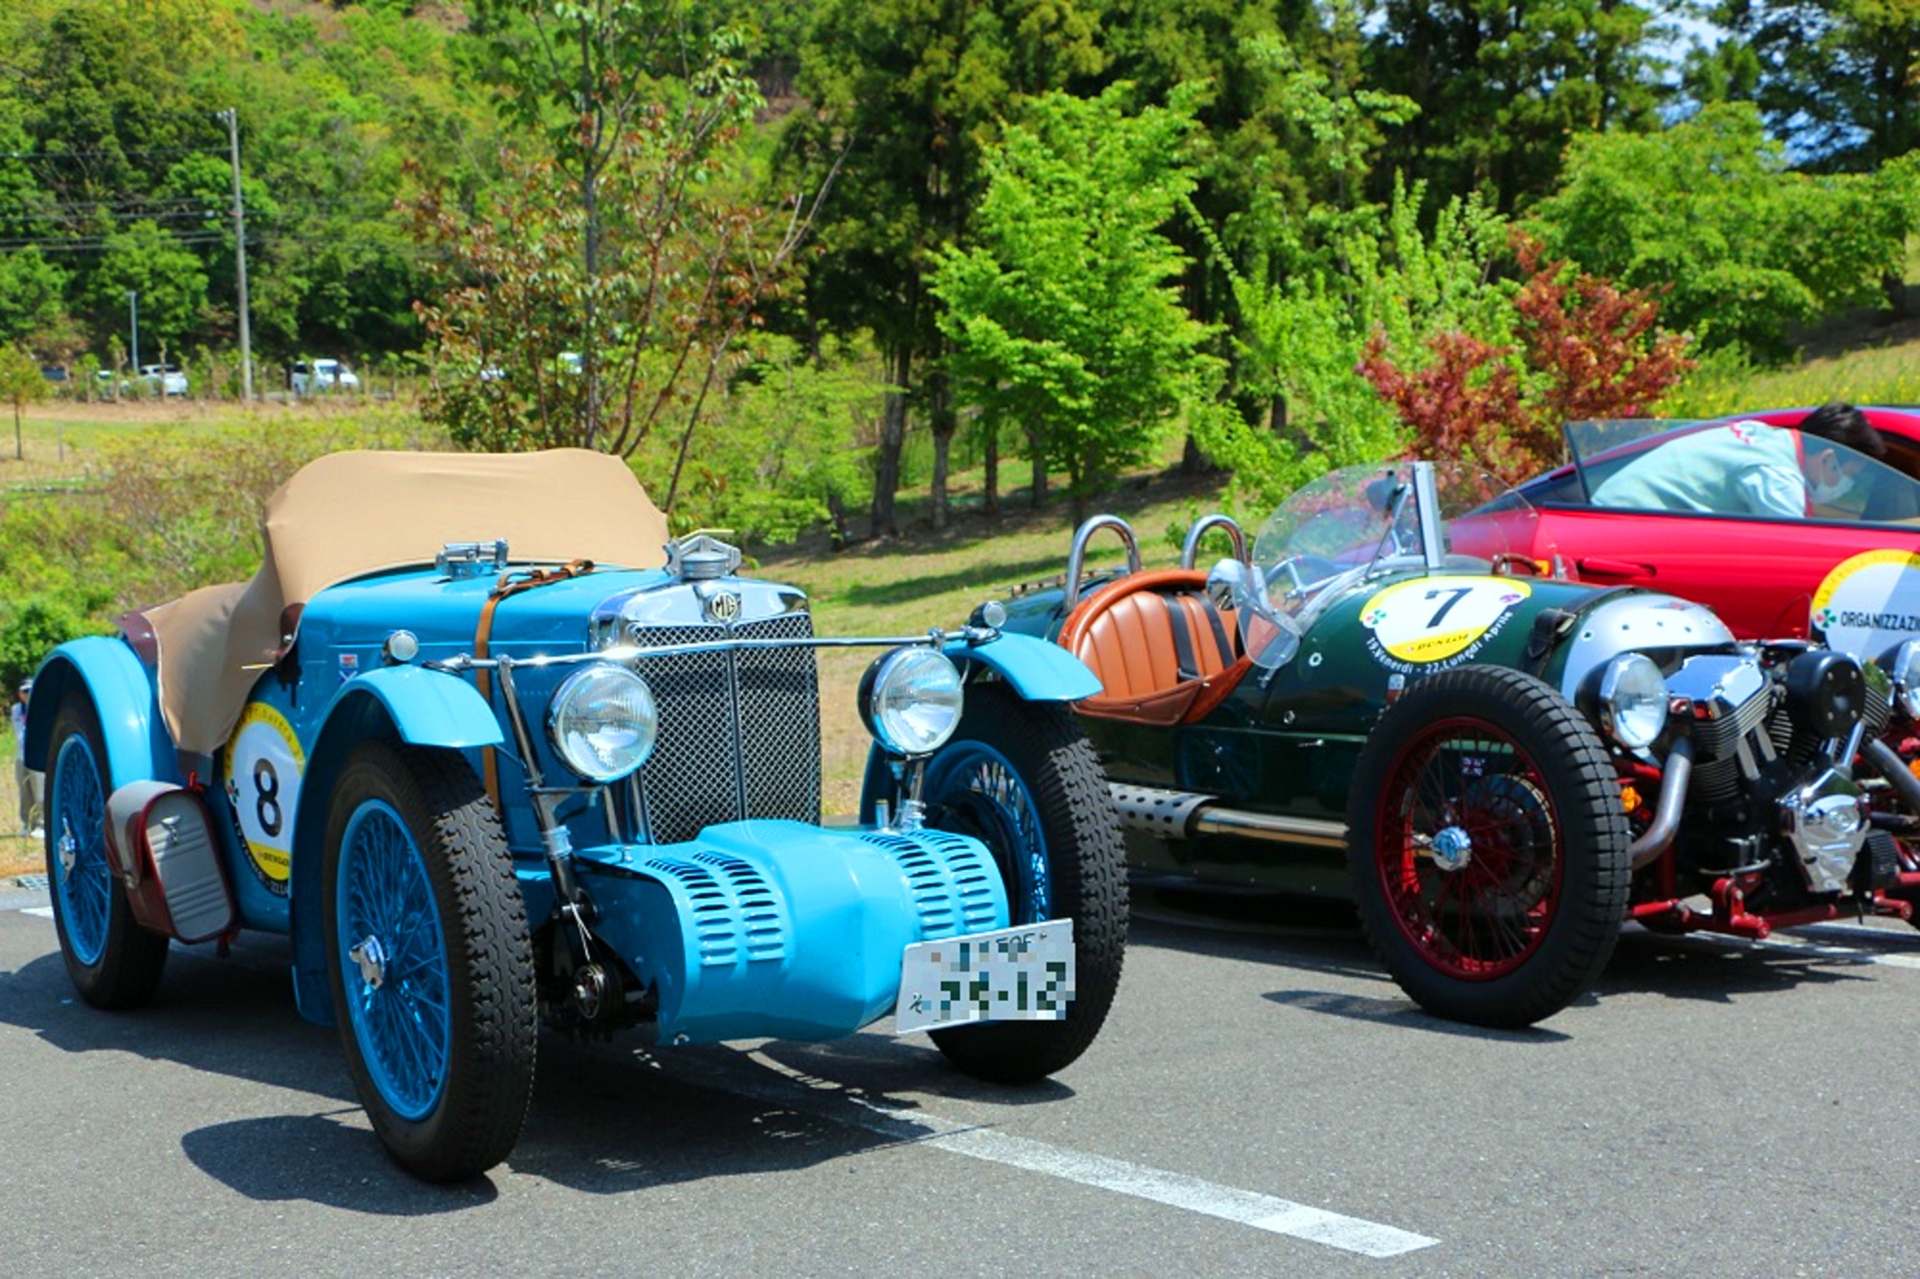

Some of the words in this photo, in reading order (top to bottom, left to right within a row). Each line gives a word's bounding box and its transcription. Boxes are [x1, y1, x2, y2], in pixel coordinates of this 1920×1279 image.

[714, 594, 738, 618] MG
[1424, 586, 1474, 628] 7
[253, 757, 282, 838] 8
